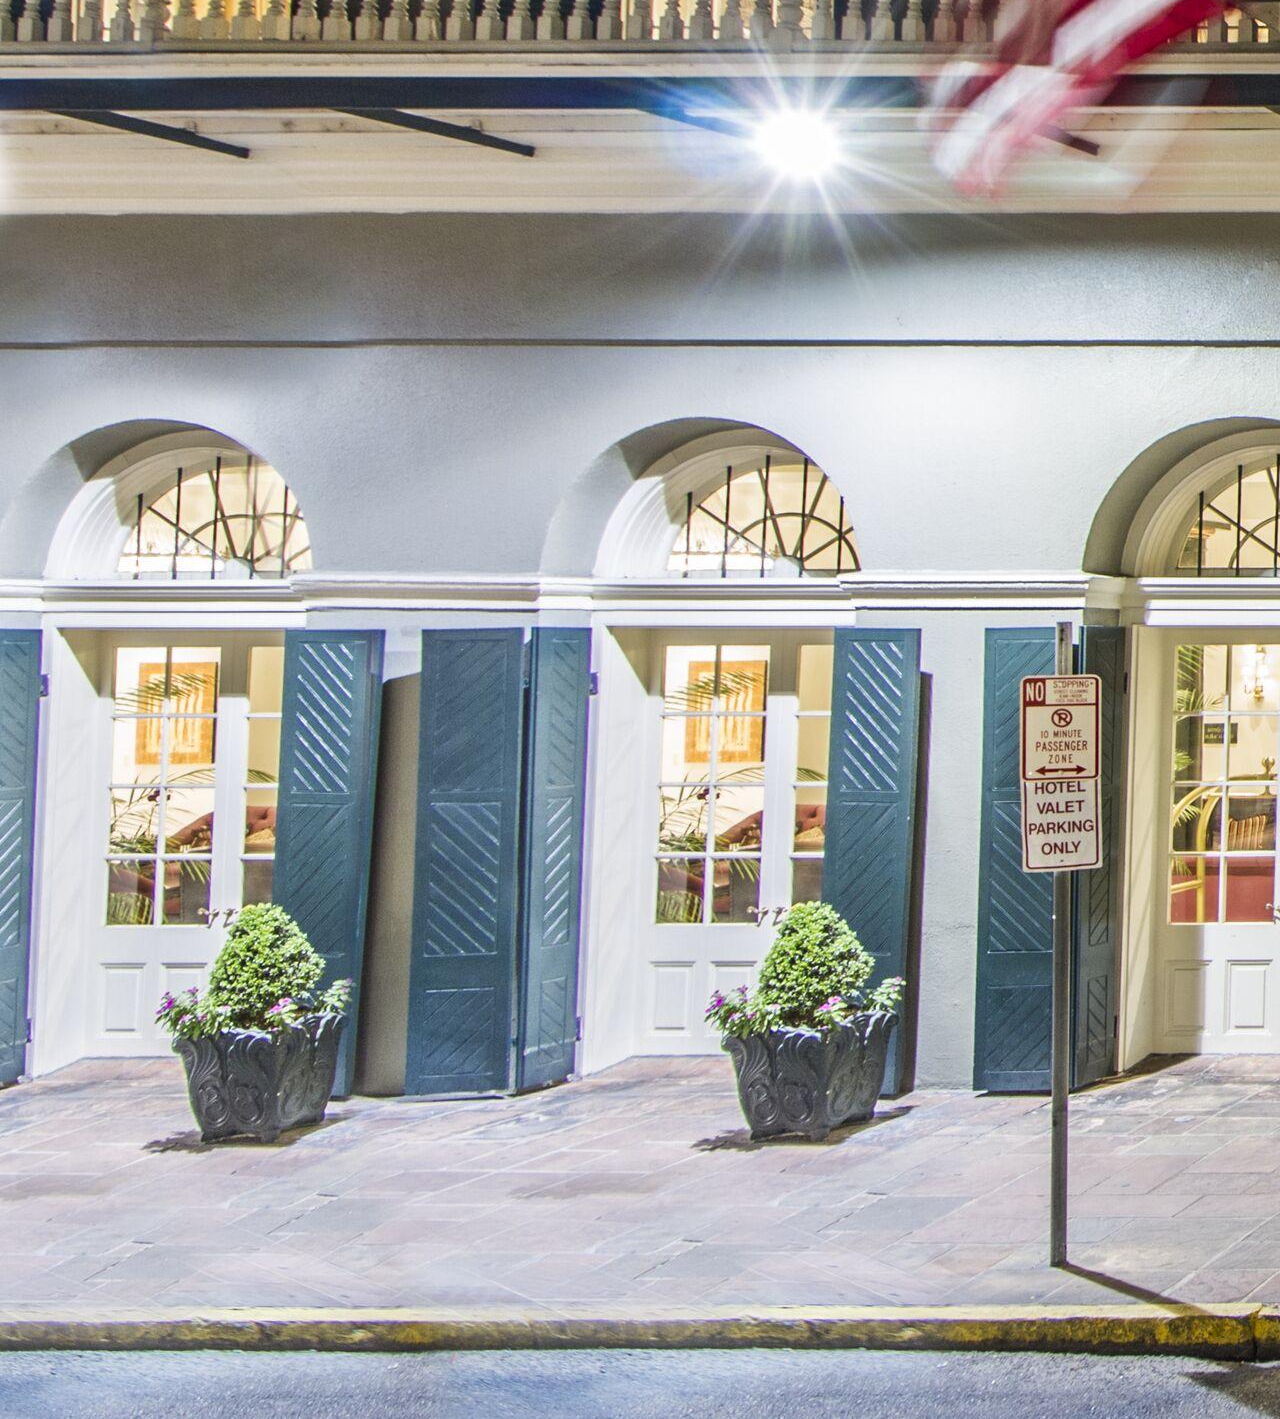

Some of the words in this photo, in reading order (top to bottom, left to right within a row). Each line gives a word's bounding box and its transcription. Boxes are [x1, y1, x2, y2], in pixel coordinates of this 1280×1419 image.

[1026, 681, 1044, 701] NO
[1053, 680, 1089, 689] STOPPING
[1041, 730, 1049, 739] 10
[1053, 729, 1083, 738] MINUTE
[1035, 740, 1088, 752] PASSENGER
[1048, 753, 1073, 764] ZONE
[1034, 780, 1086, 795] HOTEL
[1036, 800, 1085, 815] VALET
[1028, 819, 1094, 835] PARKING
[1041, 840, 1081, 855] ONLY
